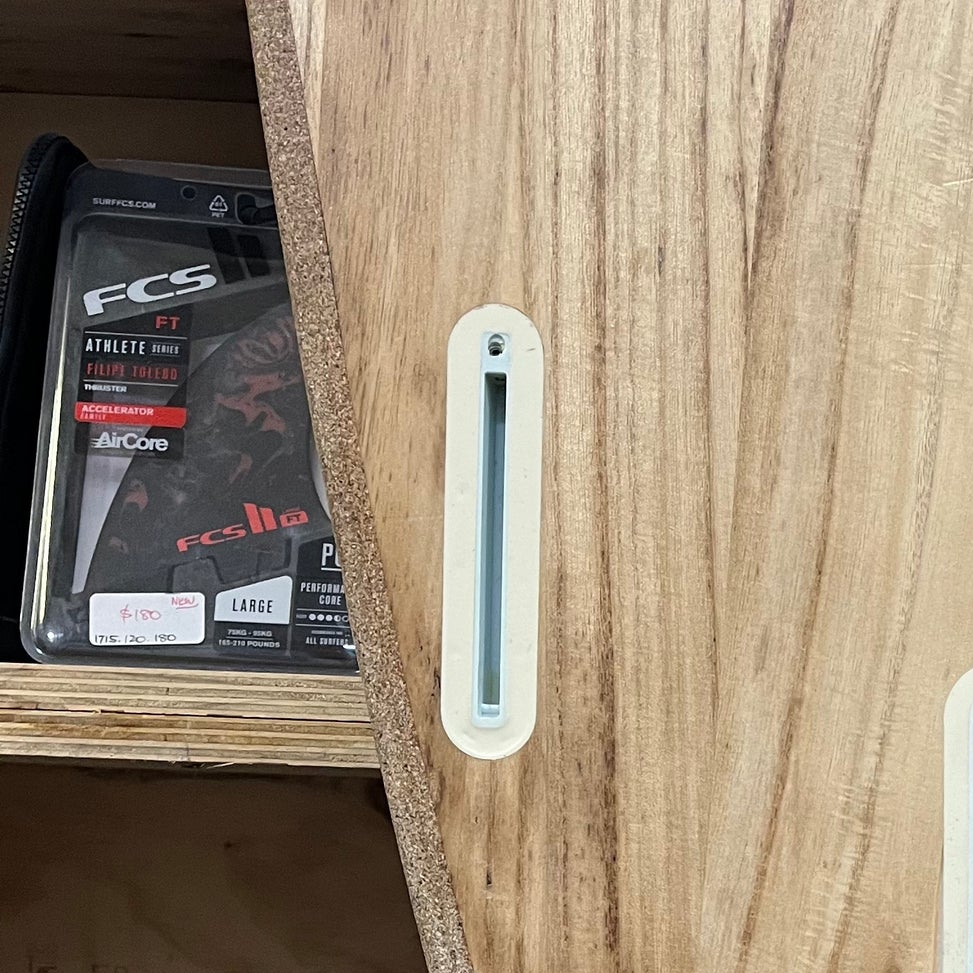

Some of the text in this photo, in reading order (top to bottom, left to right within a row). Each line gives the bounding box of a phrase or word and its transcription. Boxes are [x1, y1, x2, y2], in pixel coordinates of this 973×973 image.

[92, 197, 157, 209] SURFFCS.COM
[83, 264, 217, 316] FCS
[155, 316, 180, 330] FT
[85, 338, 179, 355] ATHLETE SERIES
[84, 383, 128, 393] THRUSTER
[82, 404, 154, 416] ACCELERATOR
[92, 431, 169, 451] AirCore
[176, 524, 247, 552] FCS
[232, 599, 273, 613] LARGE
[319, 595, 341, 606] CORE
[120, 604, 162, 623] $180
[247, 640, 280, 648] POUNDS
[305, 636, 317, 645] ALL
